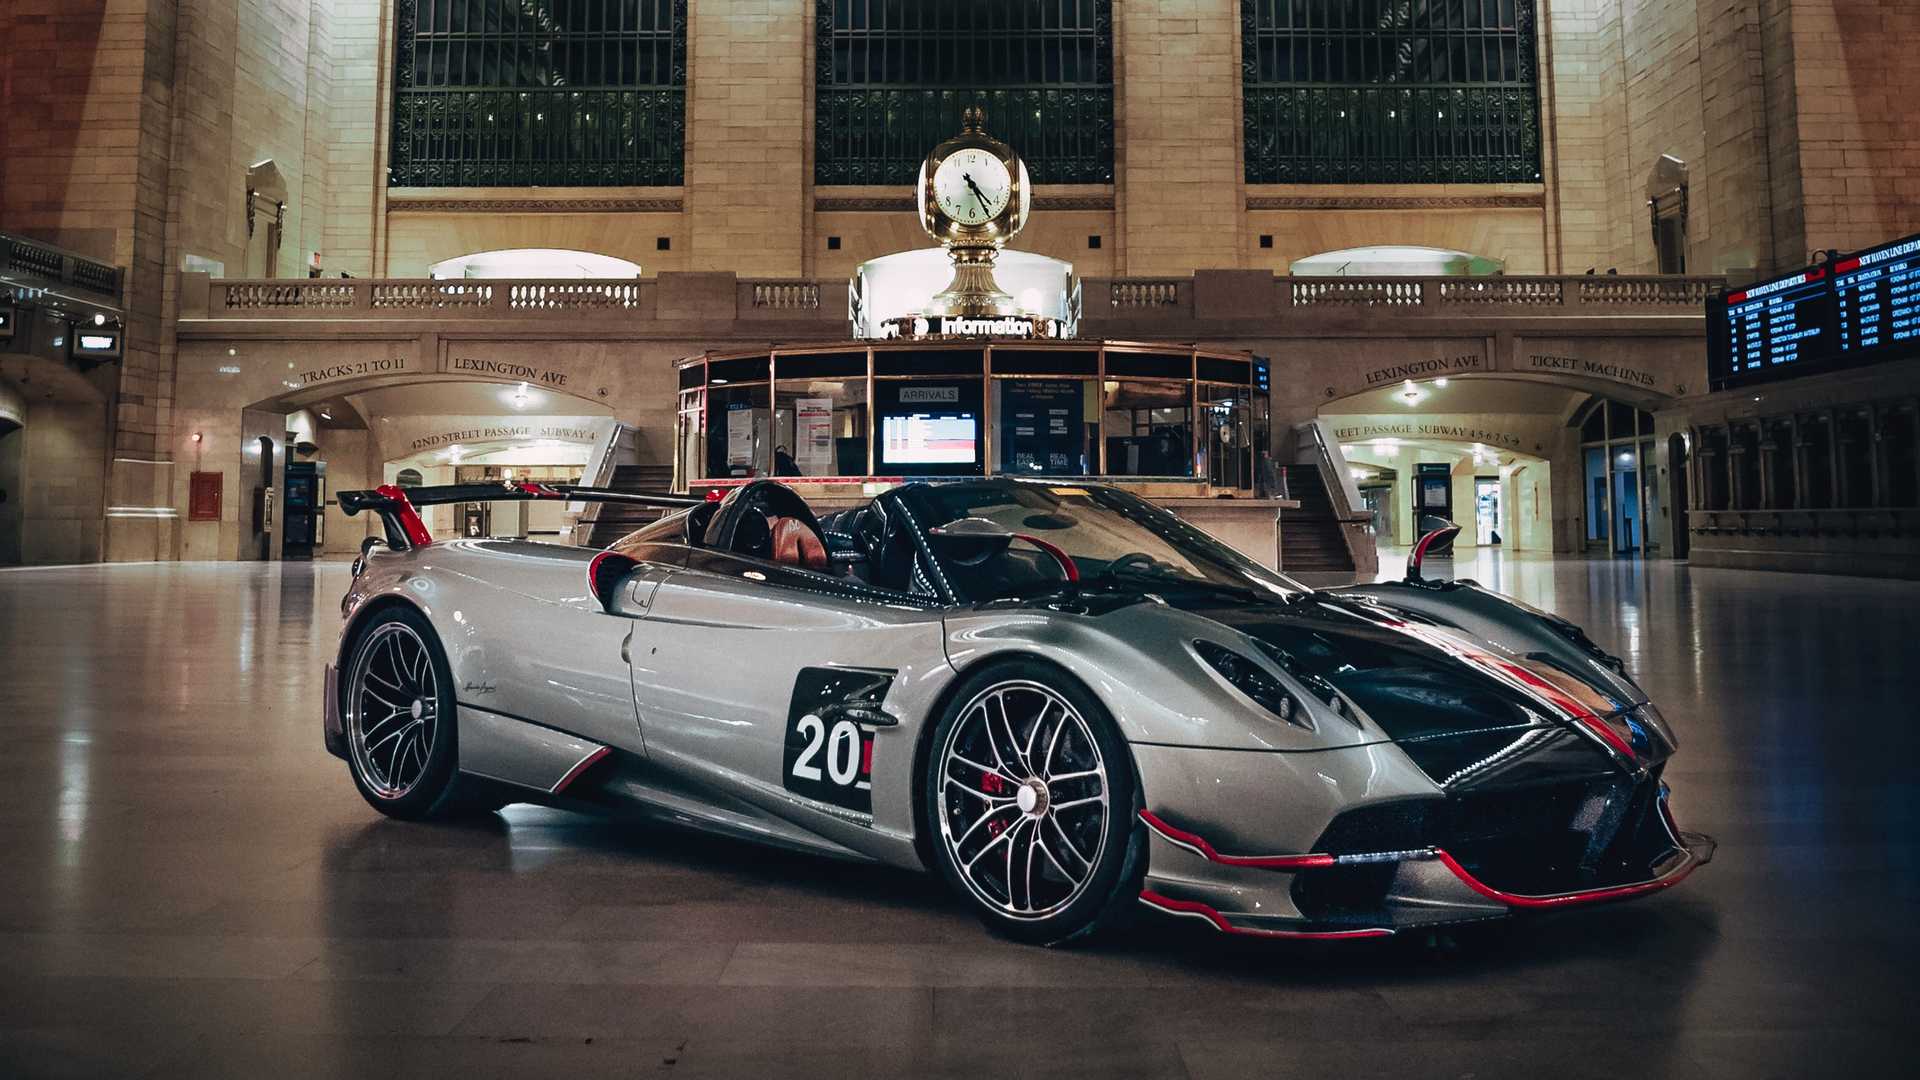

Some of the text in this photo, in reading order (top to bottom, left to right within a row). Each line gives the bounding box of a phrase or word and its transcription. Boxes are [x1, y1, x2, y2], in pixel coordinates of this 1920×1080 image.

[968, 207, 976, 219] 6
[941, 316, 1033, 336] Information
[300, 364, 353, 383] TRACKS
[356, 362, 368, 374] 21
[371, 359, 391, 371] TO
[455, 358, 567, 385] LEXINGTON AVE
[1366, 355, 1480, 384] LEXINGTON AVE
[1529, 354, 1656, 385] TICKET MACHINES
[903, 390, 956, 400] ARRIVALS
[411, 435, 440, 449] 42ND
[441, 429, 481, 443] STREET
[484, 426, 531, 437] PASSAGE
[541, 427, 586, 439] SUBWAY
[1363, 424, 1412, 435] PASSAGE
[1418, 425, 1467, 437] SUBWAY
[792, 714, 860, 786] 20
